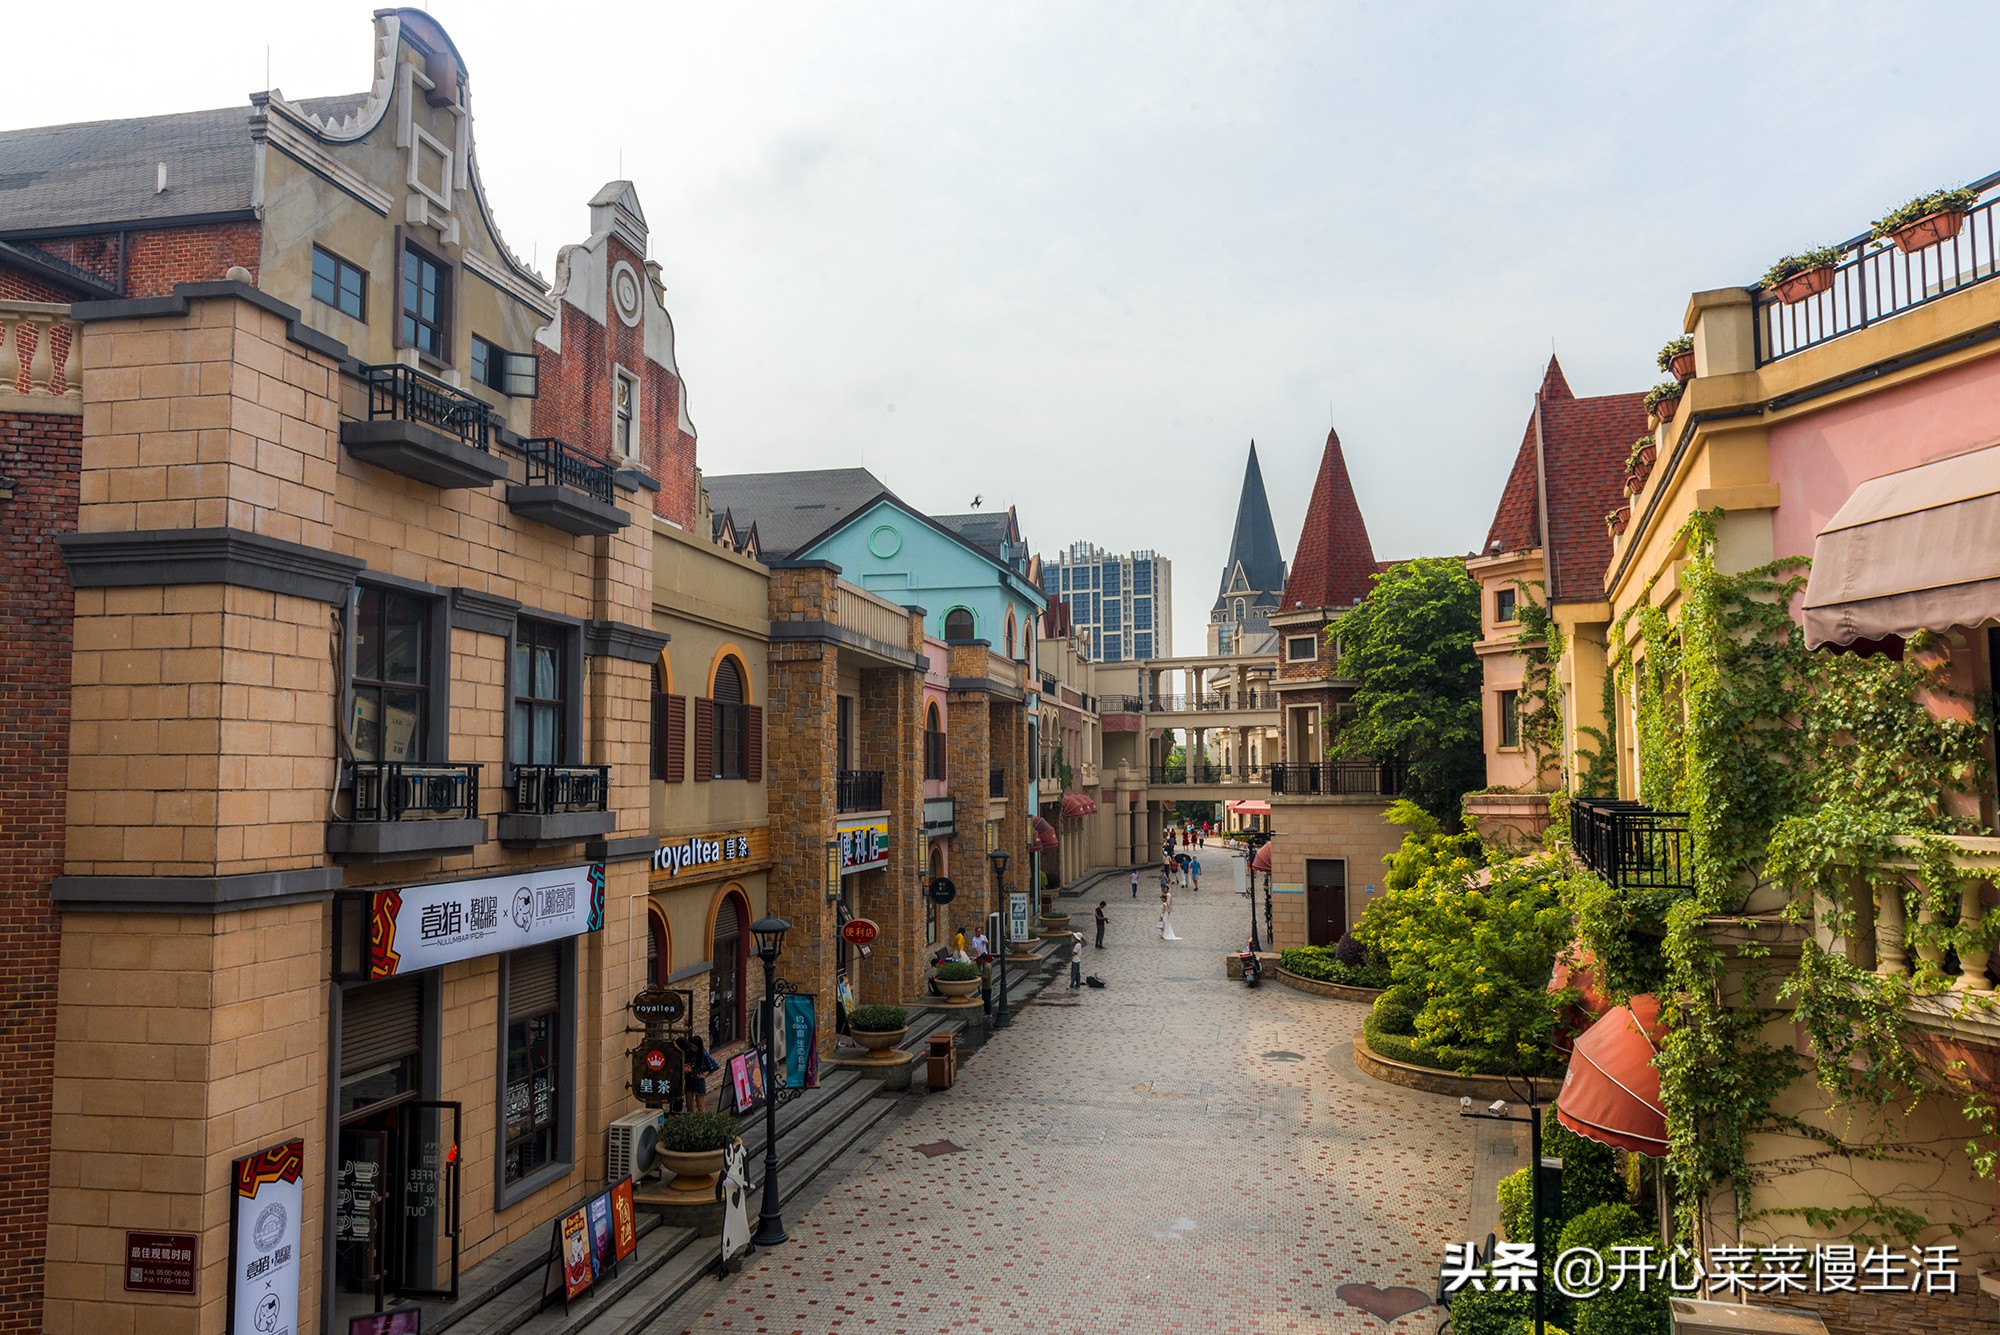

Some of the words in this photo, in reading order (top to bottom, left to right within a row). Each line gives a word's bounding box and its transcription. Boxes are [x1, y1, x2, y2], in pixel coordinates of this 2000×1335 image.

[840, 828, 879, 868] 便利店
[653, 838, 720, 876] royaltea
[726, 837, 749, 860] 皇茶
[845, 927, 874, 939] 便利店
[636, 1004, 675, 1014] royaltea
[640, 1078, 671, 1094] 皇茶
[131, 1246, 192, 1262] 最佳观鹭时间
